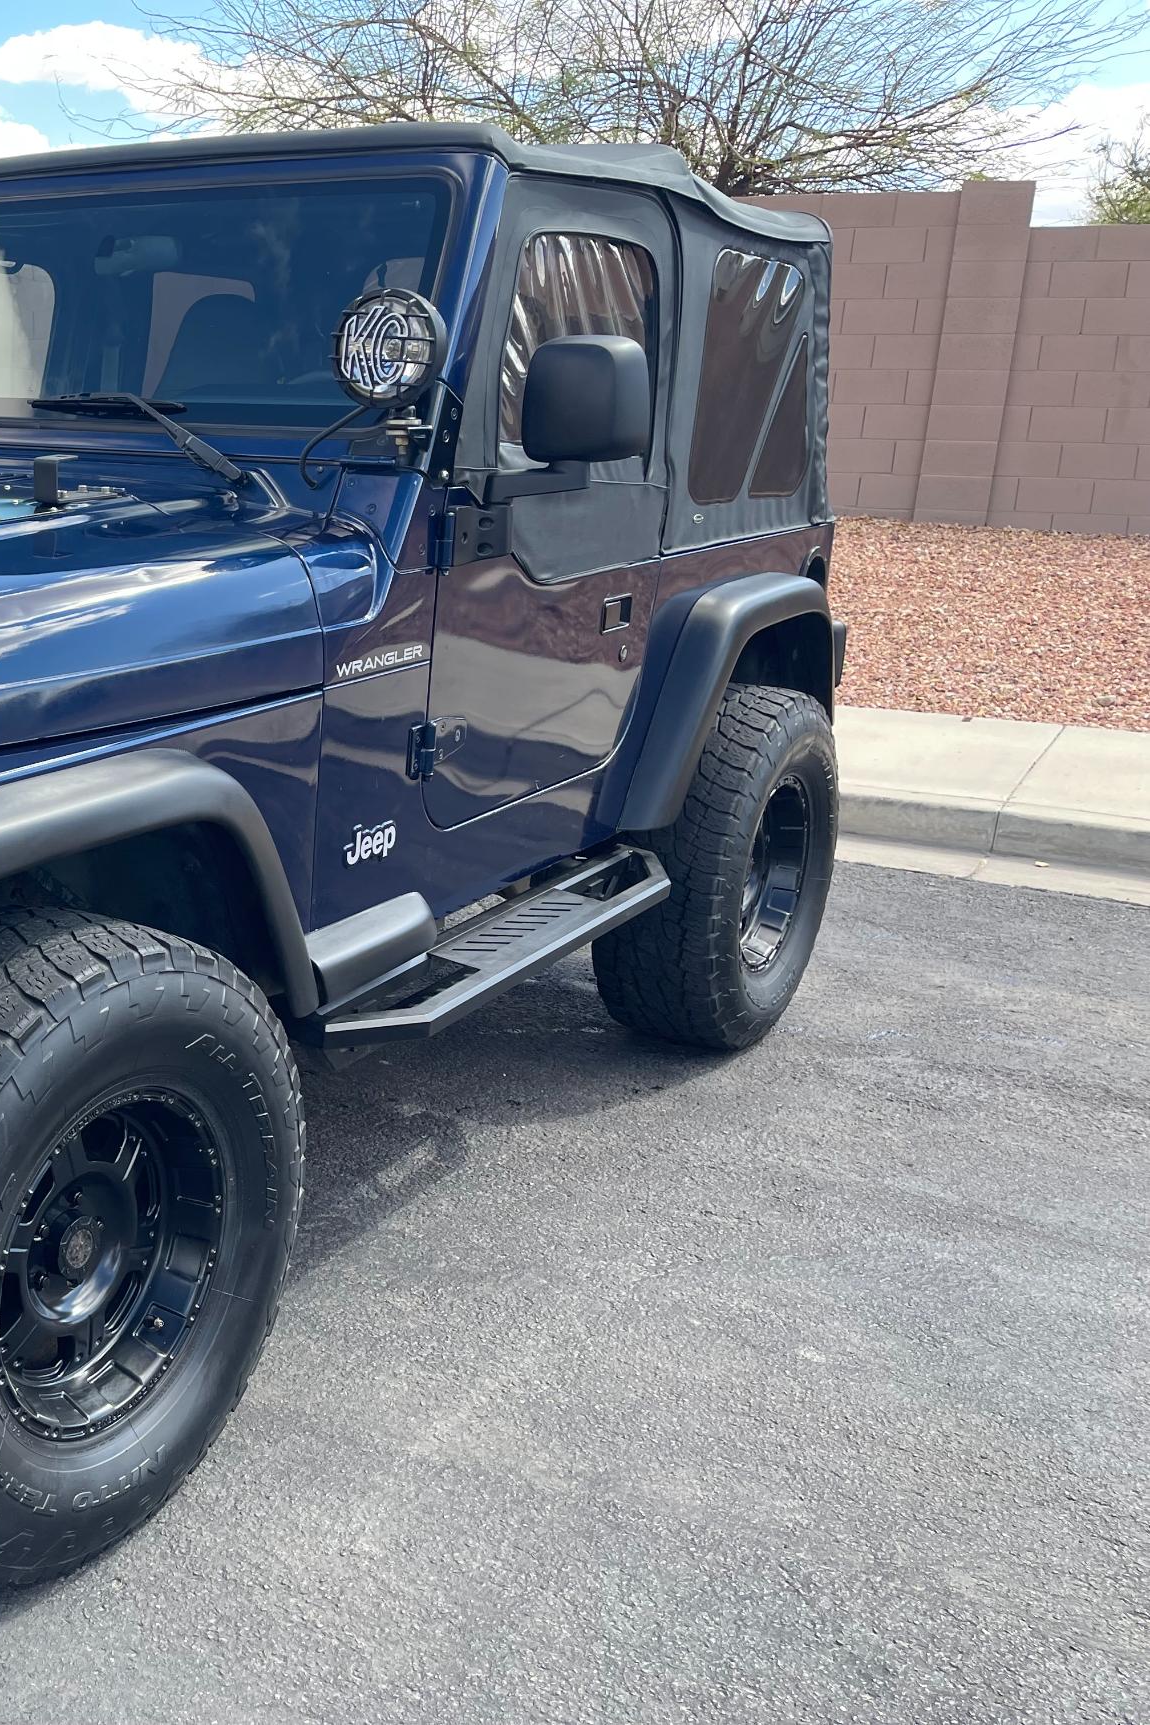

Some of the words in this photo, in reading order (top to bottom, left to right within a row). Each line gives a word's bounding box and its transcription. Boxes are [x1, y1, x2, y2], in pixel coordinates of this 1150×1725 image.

[341, 306, 409, 390] KC
[336, 645, 423, 678] WRANGLER
[344, 822, 396, 866] Jeep
[72, 1443, 167, 1513] NITTO
